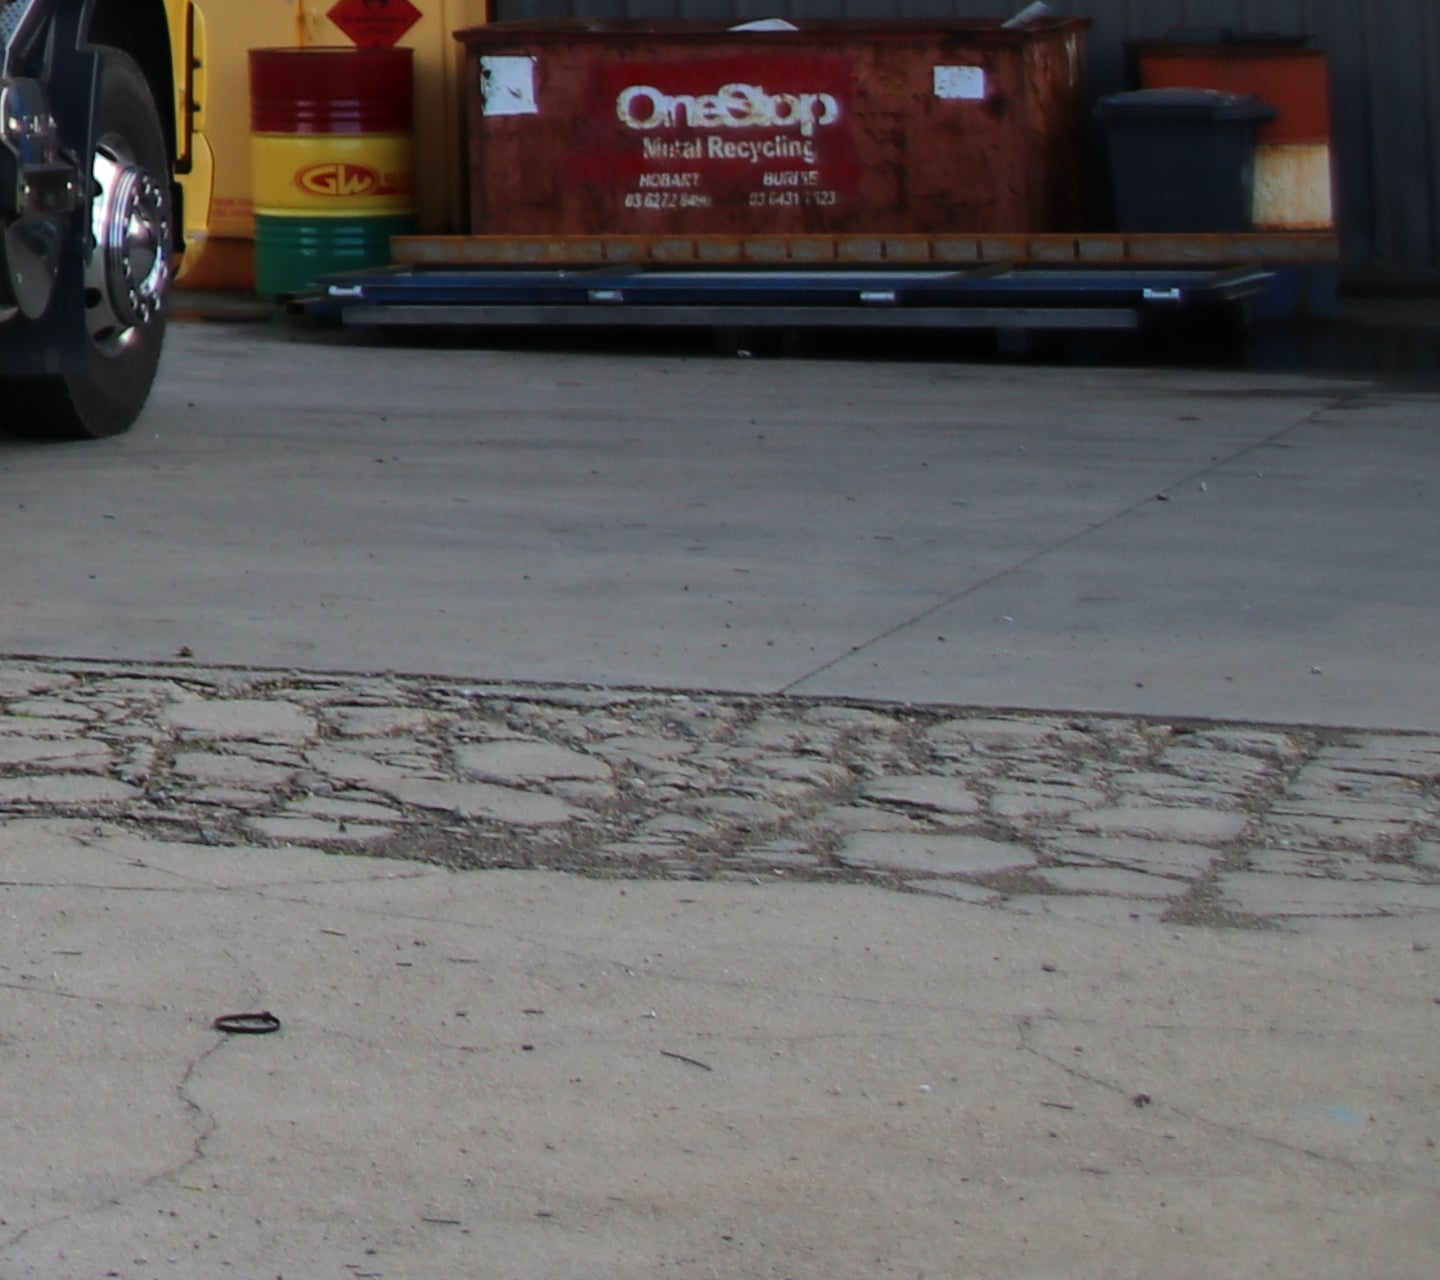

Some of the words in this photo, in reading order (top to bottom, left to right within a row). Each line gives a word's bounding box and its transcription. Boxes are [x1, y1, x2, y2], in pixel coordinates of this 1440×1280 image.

[616, 83, 840, 136] OneStop
[707, 135, 815, 163] Recycling
[639, 172, 701, 188] HOBART
